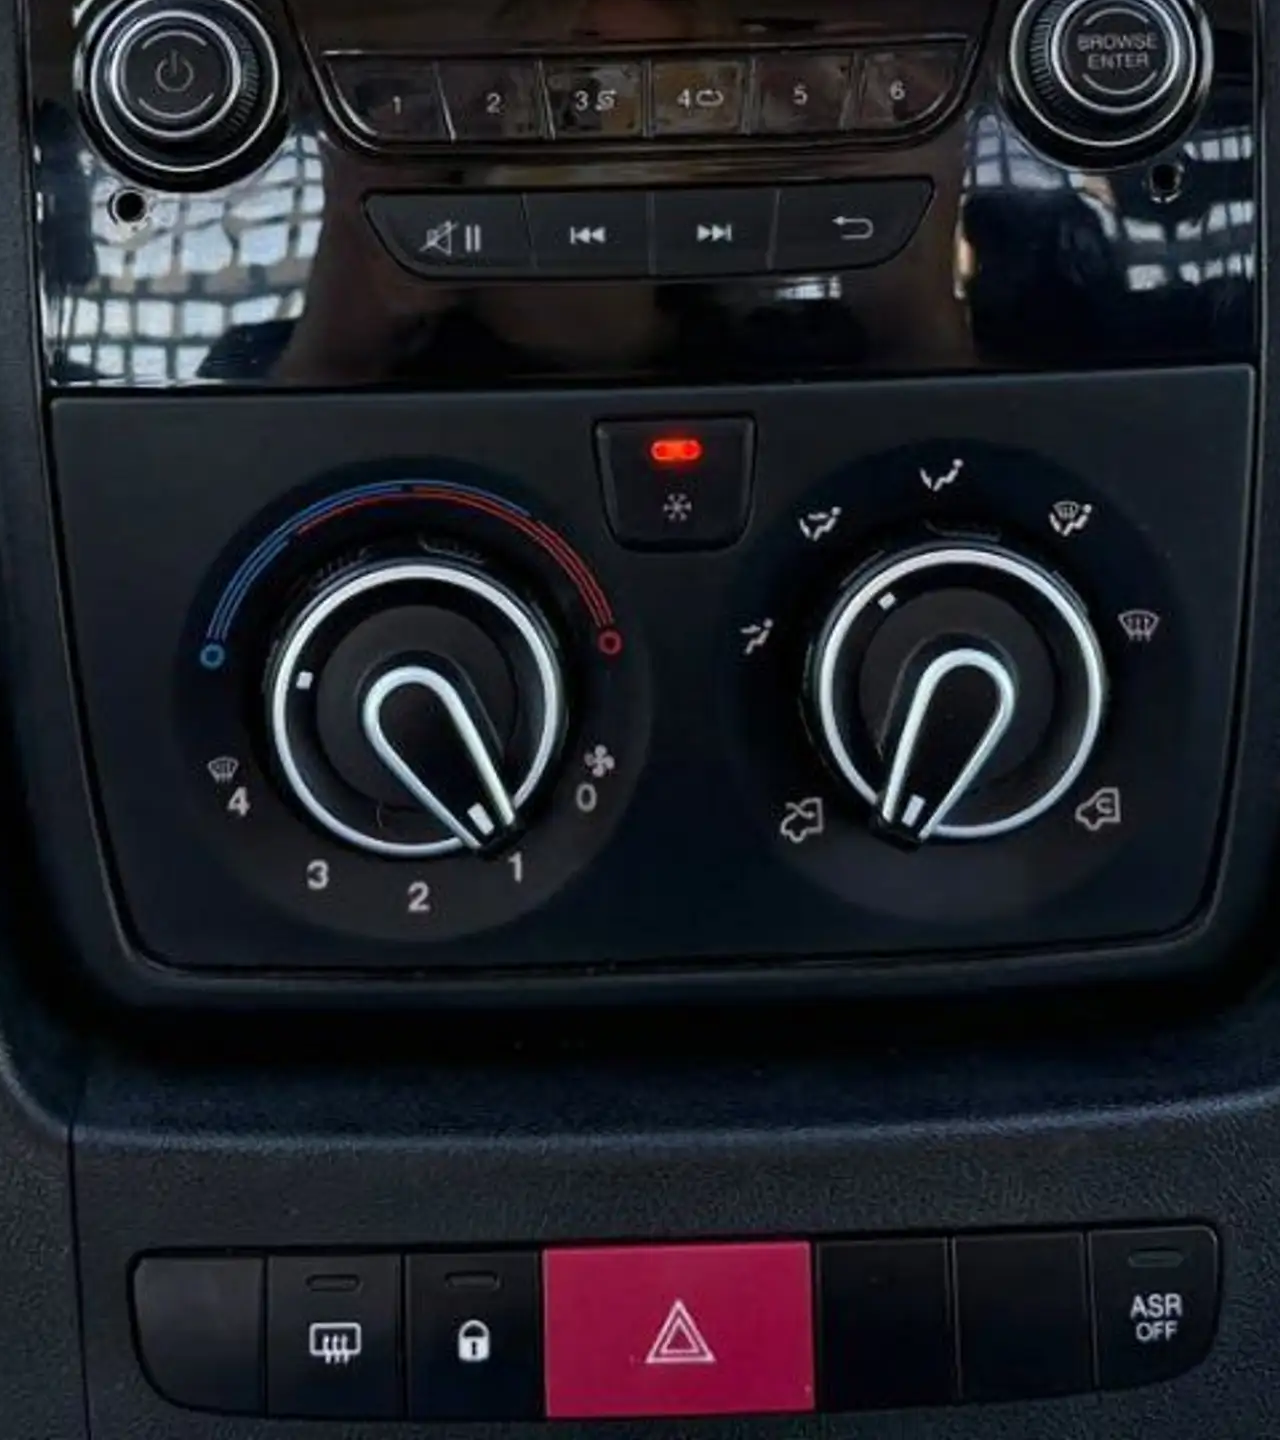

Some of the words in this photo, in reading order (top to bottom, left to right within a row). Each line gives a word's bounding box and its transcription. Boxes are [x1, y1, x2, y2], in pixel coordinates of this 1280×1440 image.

[1077, 32, 1159, 52] BROWSE
[1087, 52, 1150, 71] ENTER
[574, 89, 590, 111] 3
[676, 87, 692, 110] 4
[792, 83, 809, 106] 5
[888, 79, 906, 102] 6
[391, 95, 403, 115] 1
[485, 91, 502, 114] 2
[226, 785, 251, 818] 4
[575, 782, 598, 813] 0
[305, 859, 330, 891] 3
[507, 851, 524, 882] 1
[406, 881, 431, 913] 2
[1129, 1292, 1183, 1319] ASR
[1135, 1320, 1179, 1343] OFF
